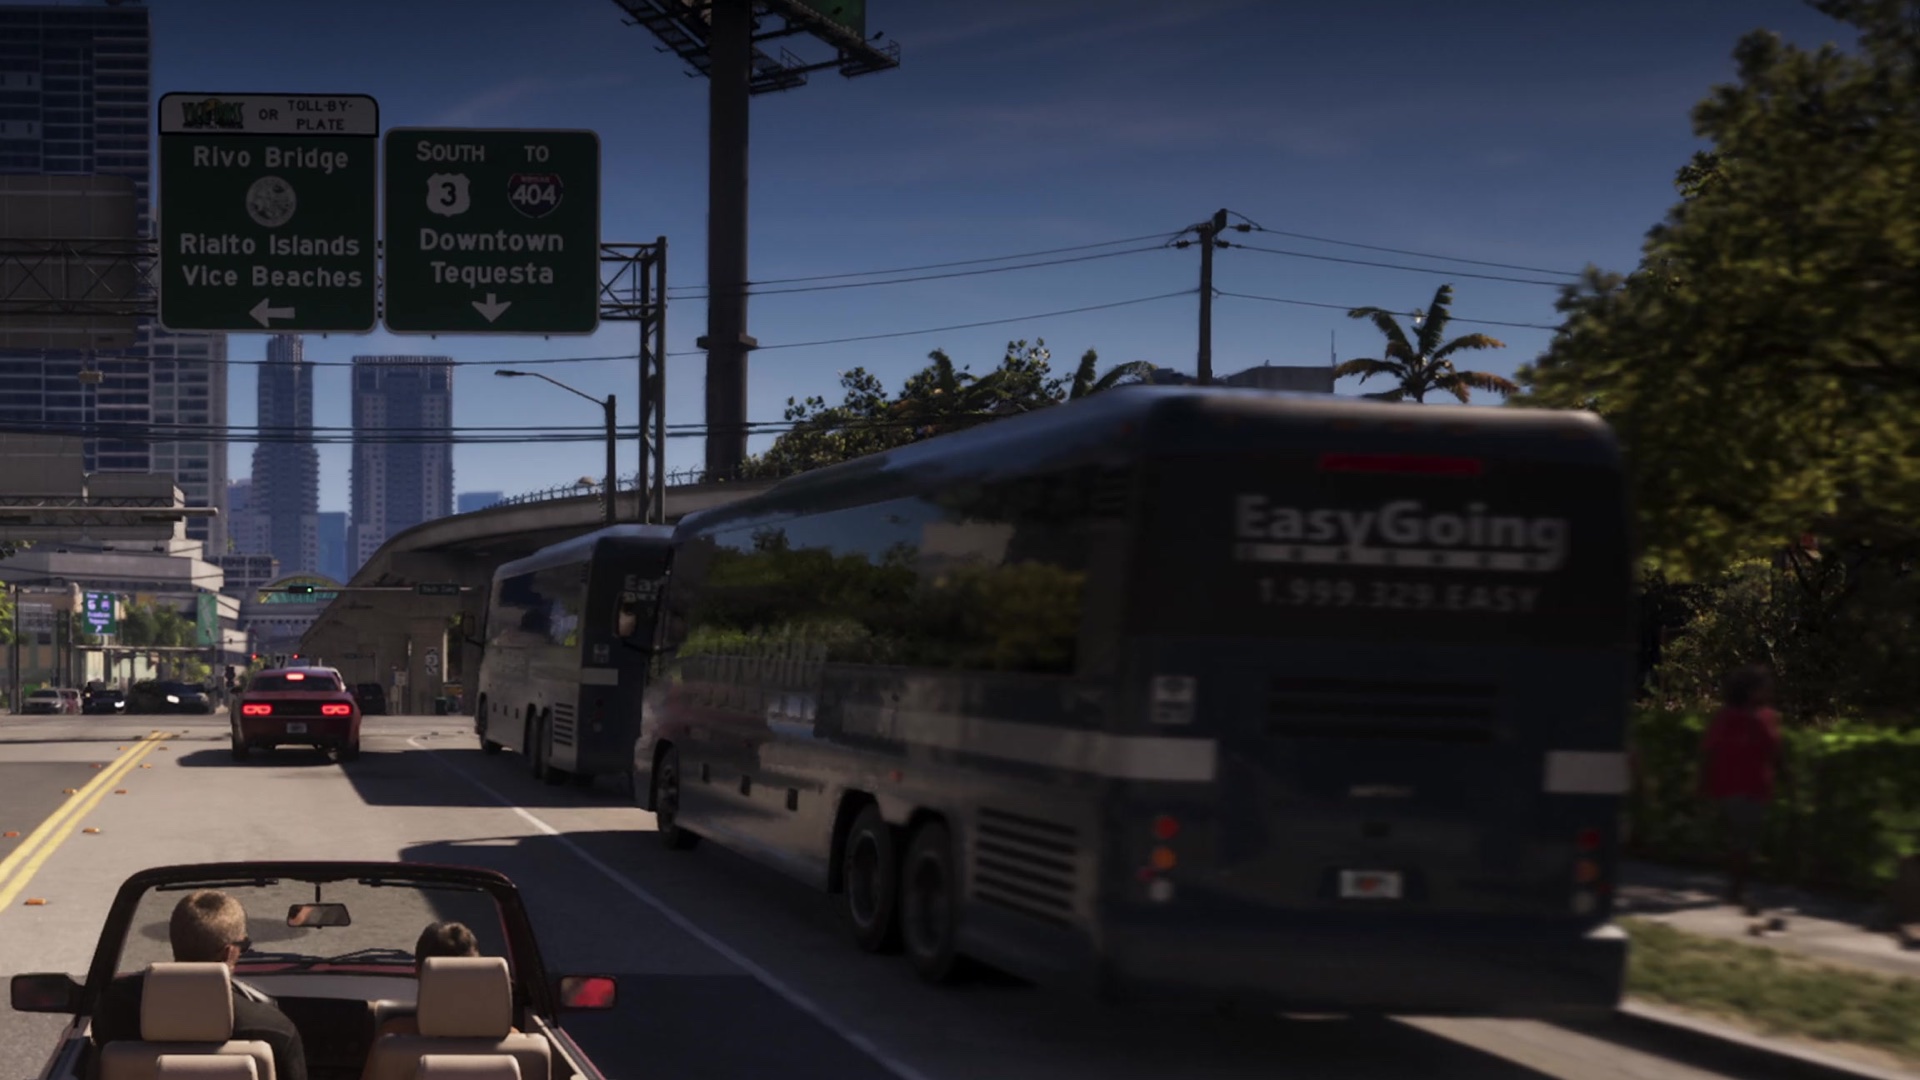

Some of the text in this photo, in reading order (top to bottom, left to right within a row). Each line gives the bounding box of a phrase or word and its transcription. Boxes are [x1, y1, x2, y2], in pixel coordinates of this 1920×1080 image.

[258, 108, 279, 121] OR
[287, 99, 354, 112] TOLL-BY-
[296, 118, 345, 131] PLATE
[193, 145, 349, 175] Rivo Bridge
[416, 140, 550, 163] SOUTH TO
[440, 181, 457, 207] 3
[512, 183, 557, 209] 404
[180, 232, 360, 256] Rialto Islands
[419, 227, 564, 252] Downtown
[181, 264, 362, 288] Vice Beaches
[430, 260, 554, 288] Tequesta
[1234, 494, 1569, 571] EasyGoing
